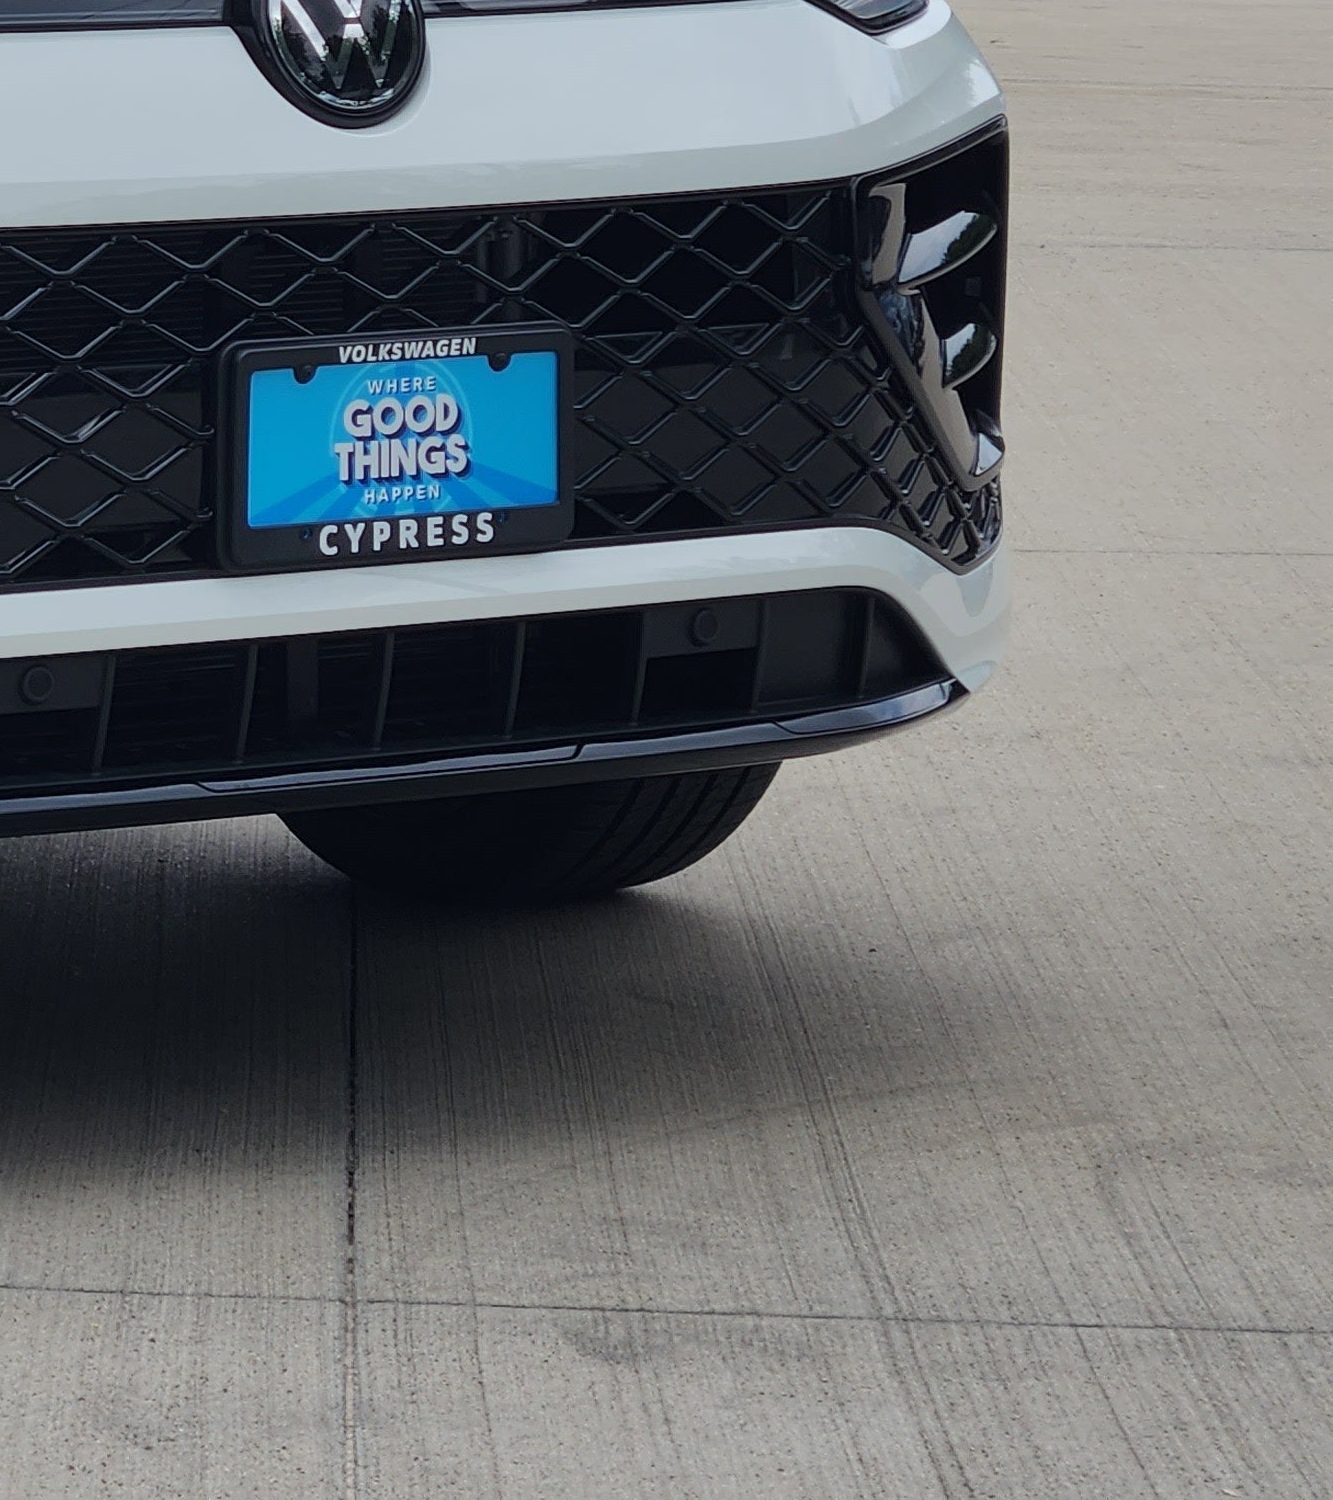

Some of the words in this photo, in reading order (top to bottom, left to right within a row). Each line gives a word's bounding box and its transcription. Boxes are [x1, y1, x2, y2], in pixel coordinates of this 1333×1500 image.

[338, 337, 477, 364] VOLKSWAGEN
[367, 376, 437, 394] WHERE
[343, 393, 459, 439] GOOD
[335, 434, 469, 481] THINGS
[364, 484, 441, 504] HAPPEN
[319, 512, 495, 556] CYPRESS
